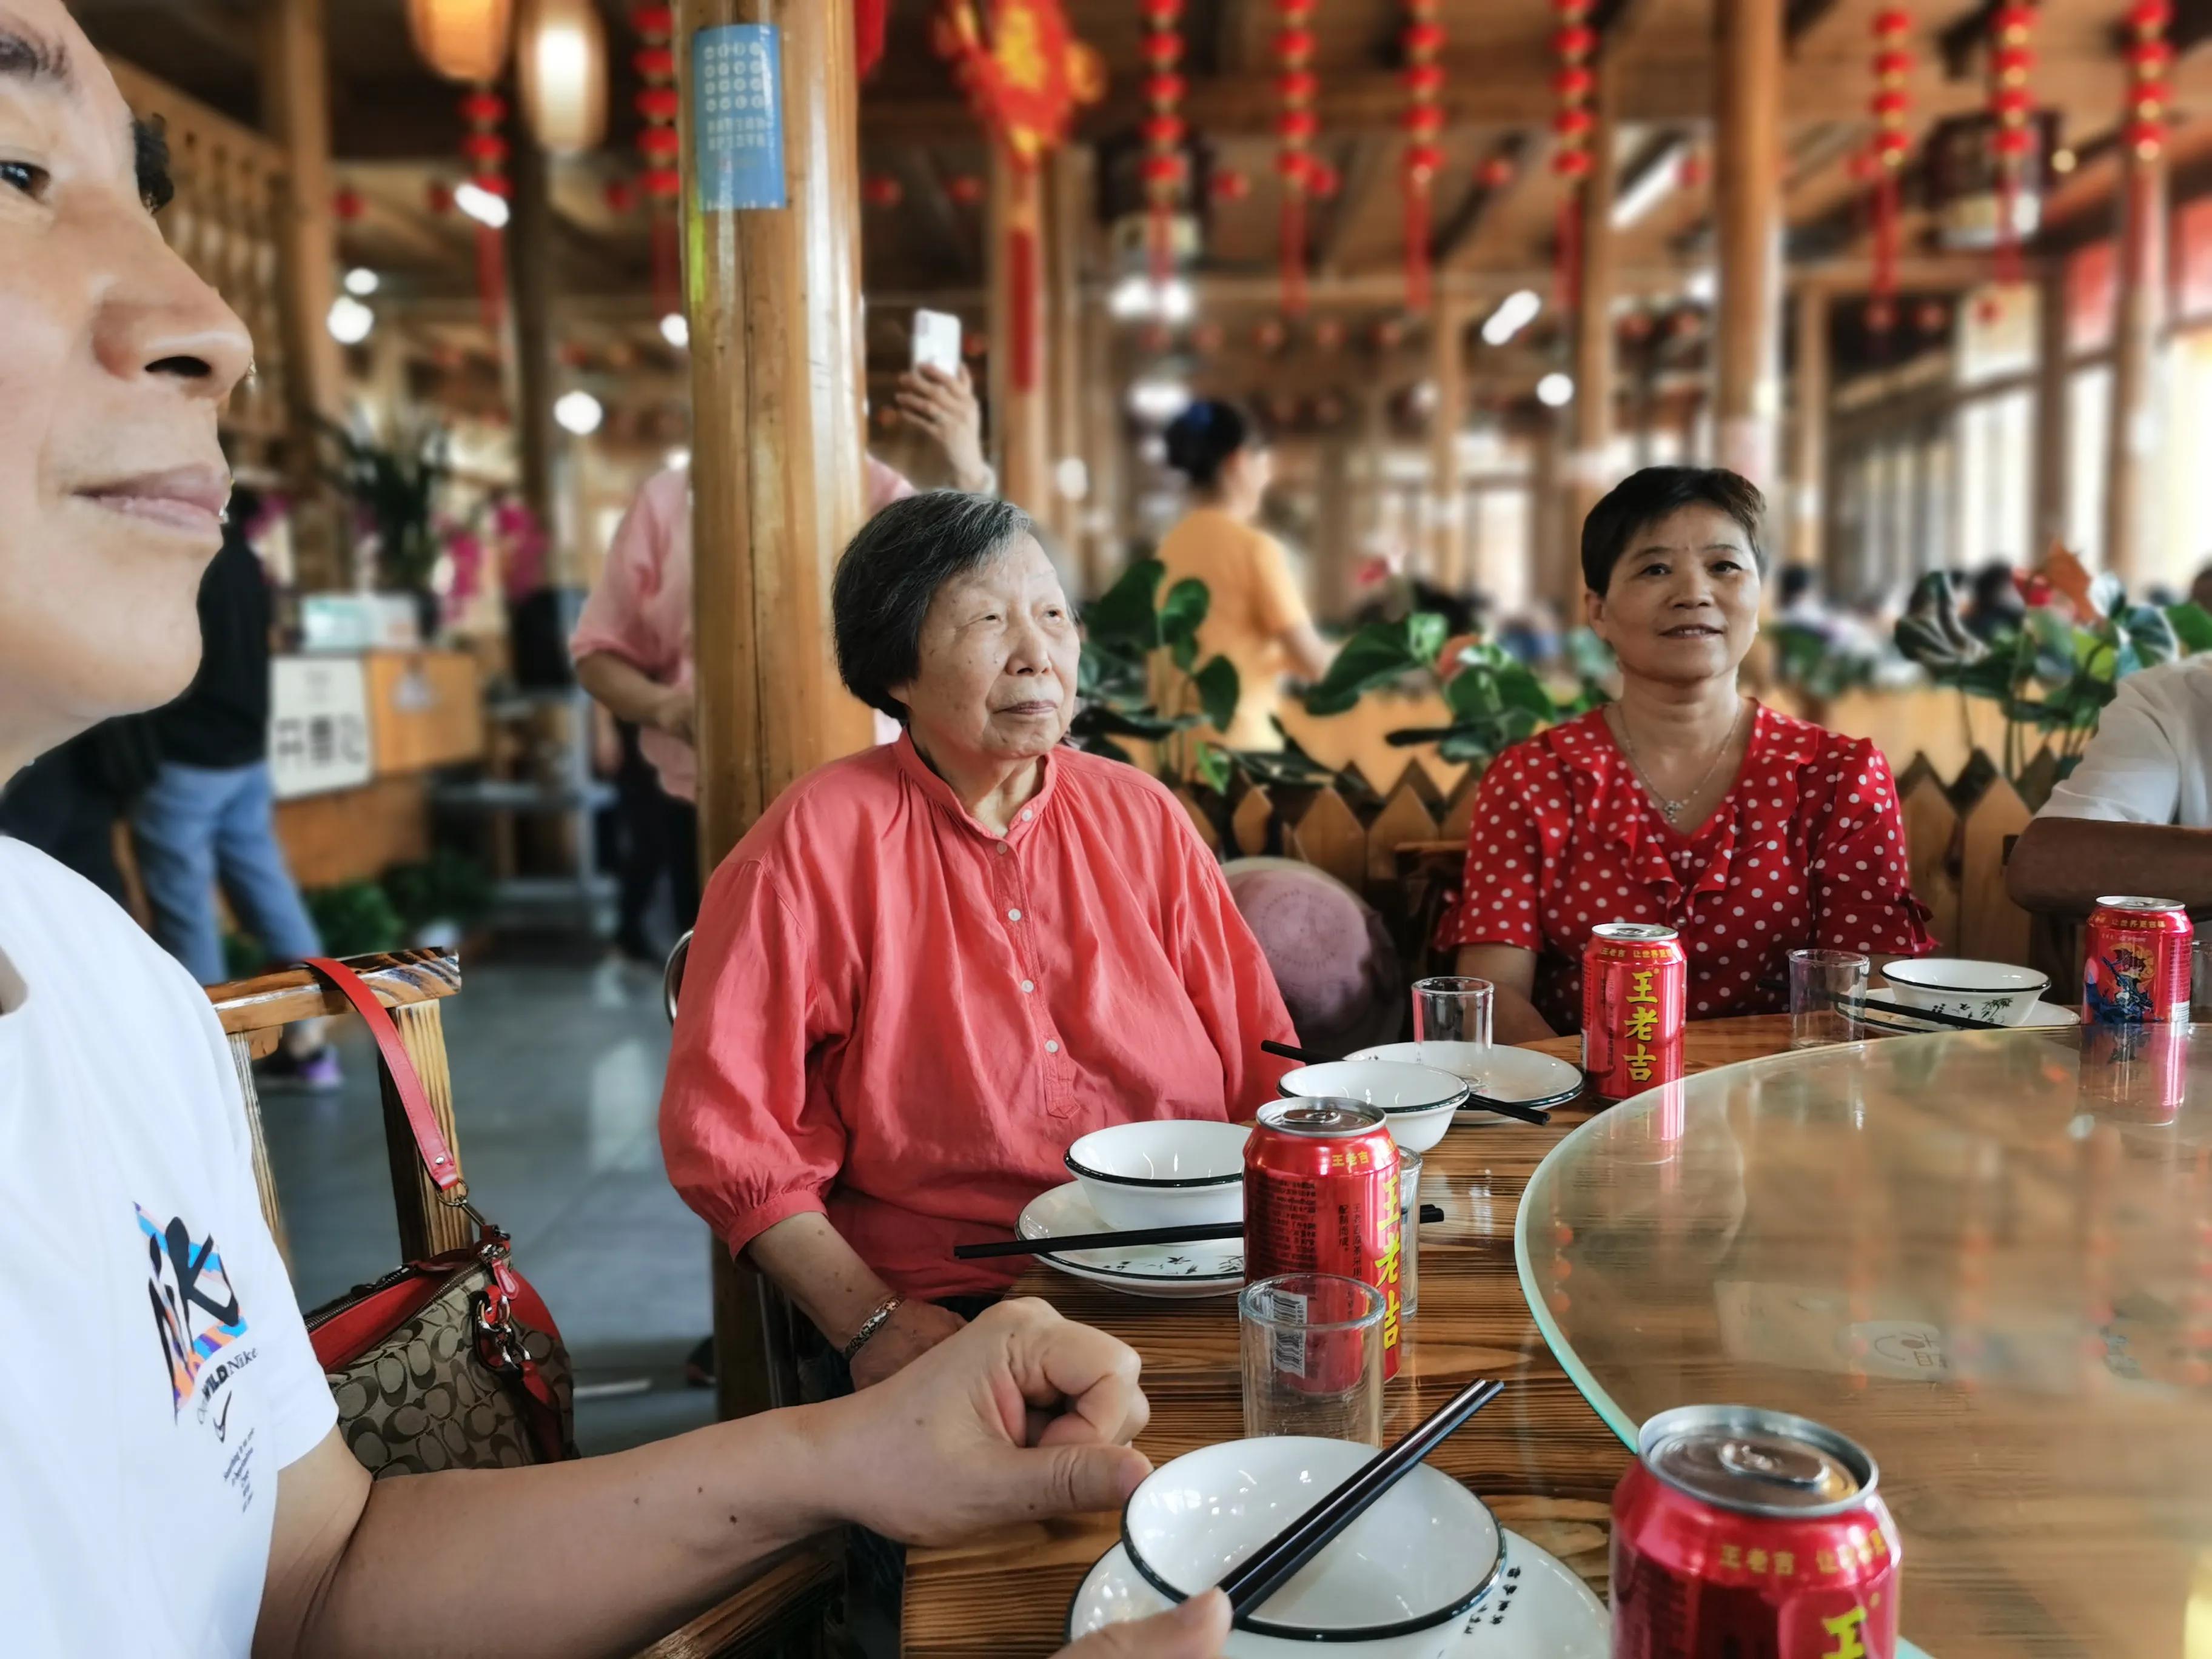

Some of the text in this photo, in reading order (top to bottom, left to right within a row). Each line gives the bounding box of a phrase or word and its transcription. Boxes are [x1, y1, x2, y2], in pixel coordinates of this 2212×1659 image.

[1623, 971, 1659, 1082] 王老吉
[1332, 1151, 1369, 1167] 王老吉
[1375, 1174, 1401, 1350] 王老吉
[227, 1347, 257, 1375] Nike
